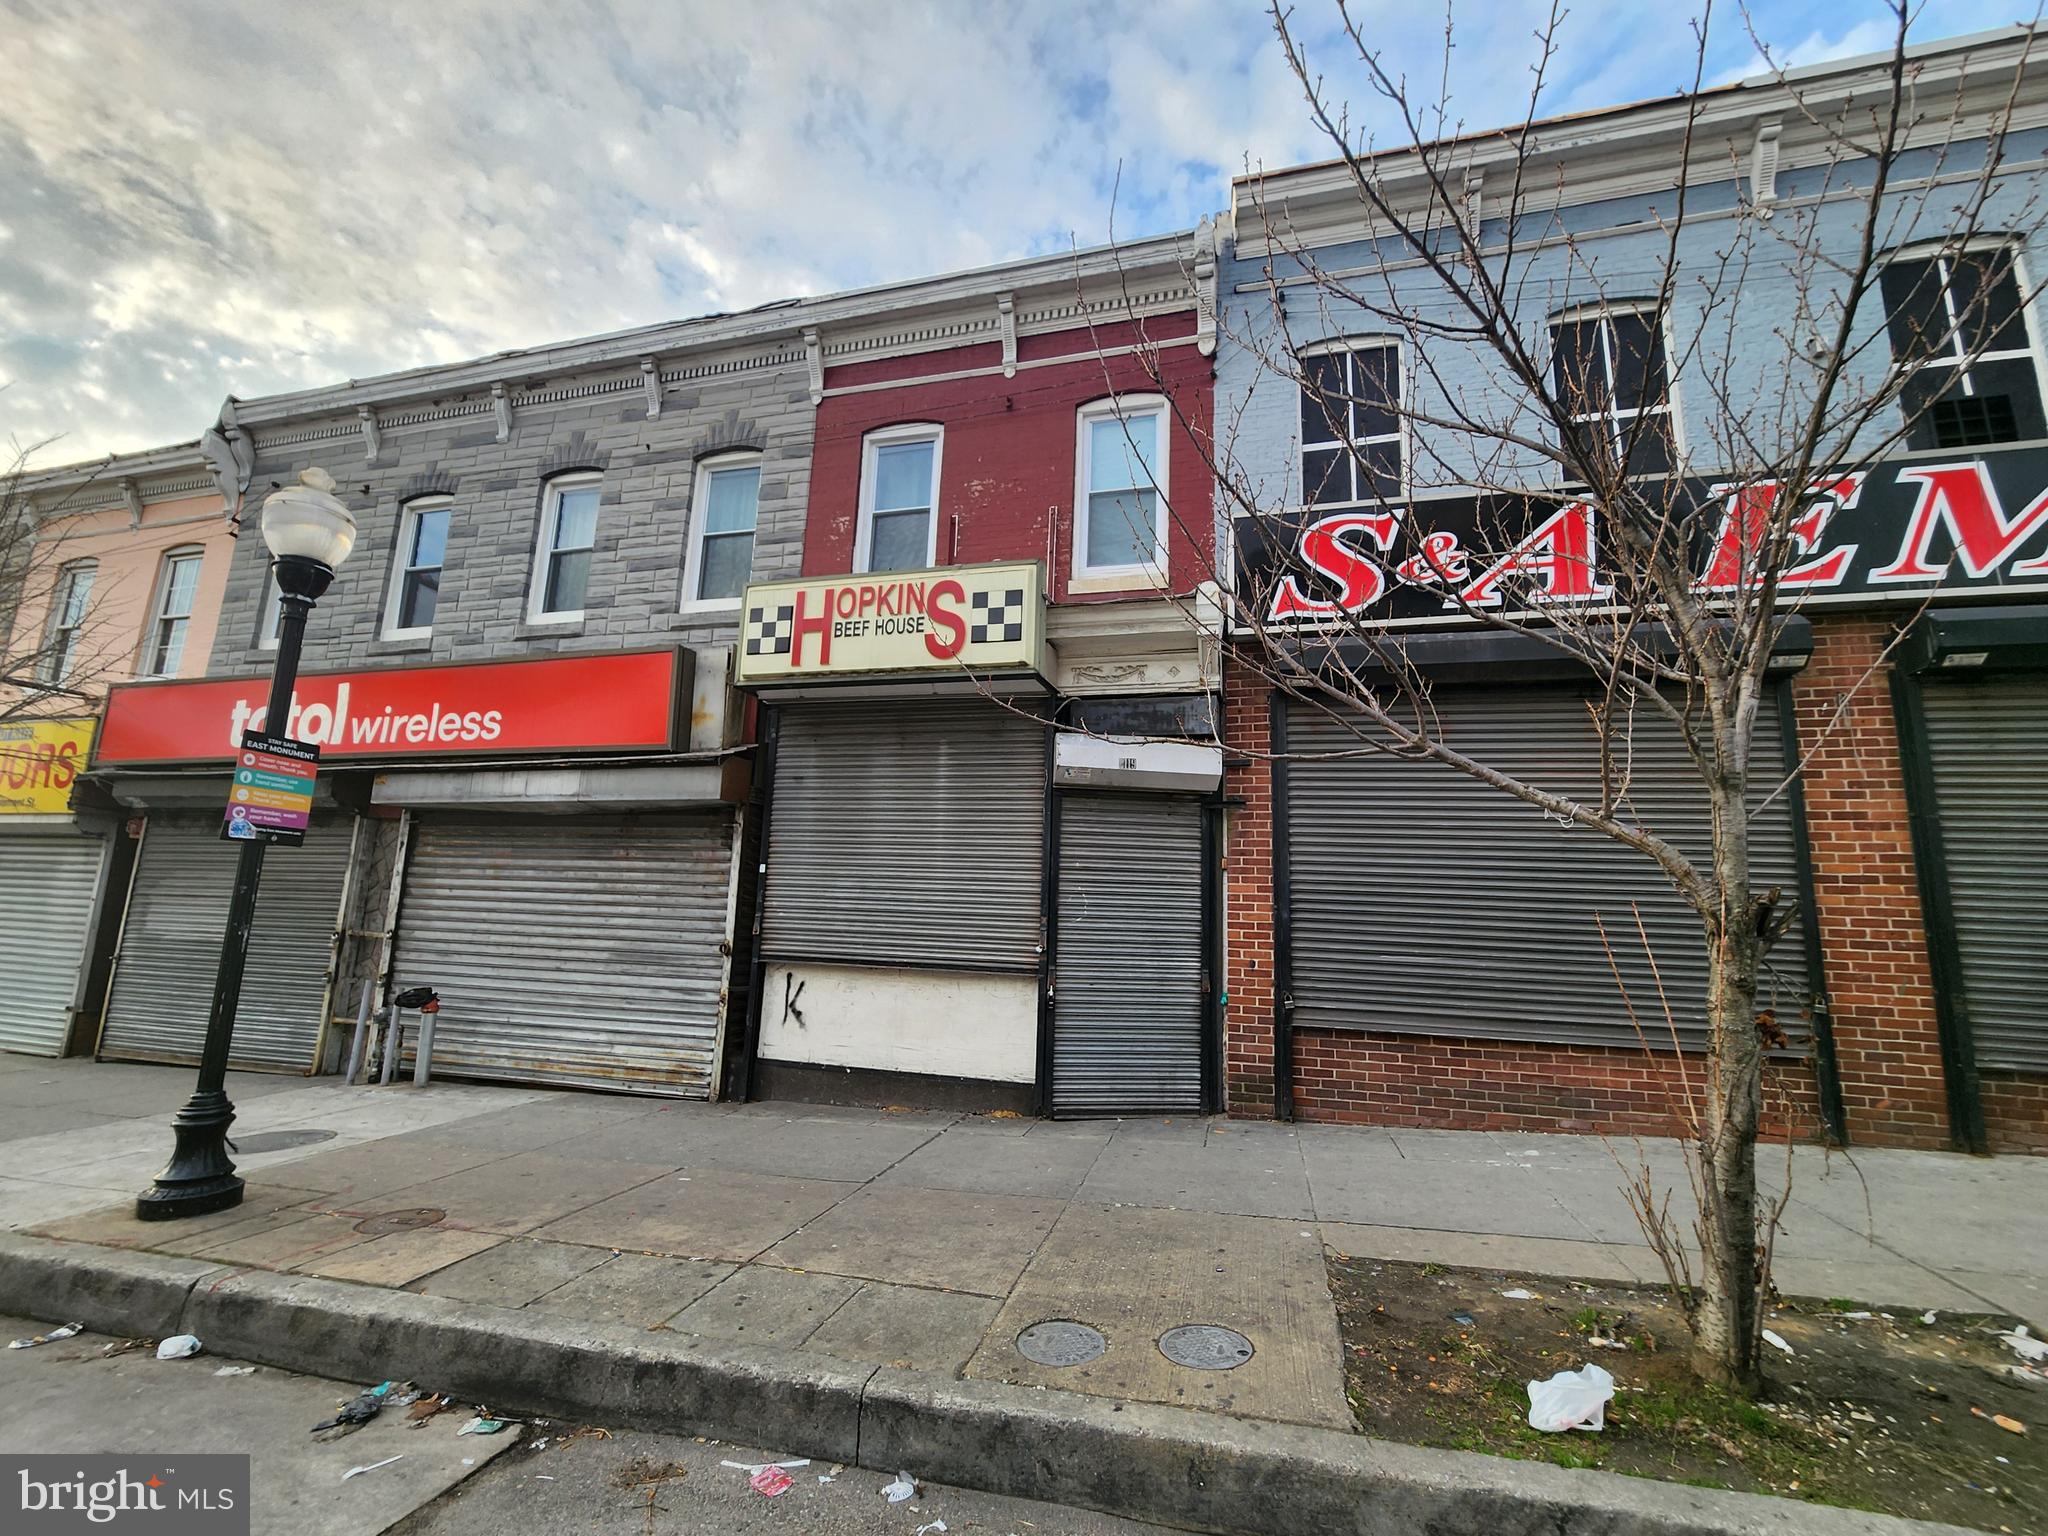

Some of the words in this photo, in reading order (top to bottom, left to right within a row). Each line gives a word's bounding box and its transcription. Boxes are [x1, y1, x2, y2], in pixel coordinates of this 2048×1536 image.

[790, 580, 965, 667] HOPKINS
[834, 619, 869, 638] BEEF
[874, 616, 925, 636] HOUSE
[352, 702, 503, 744] wireless
[247, 740, 268, 751] EAST
[269, 745, 315, 760] MONUMENT
[268, 738, 282, 746] STAY
[283, 741, 298, 749] SAFE
[782, 971, 807, 1032] K
